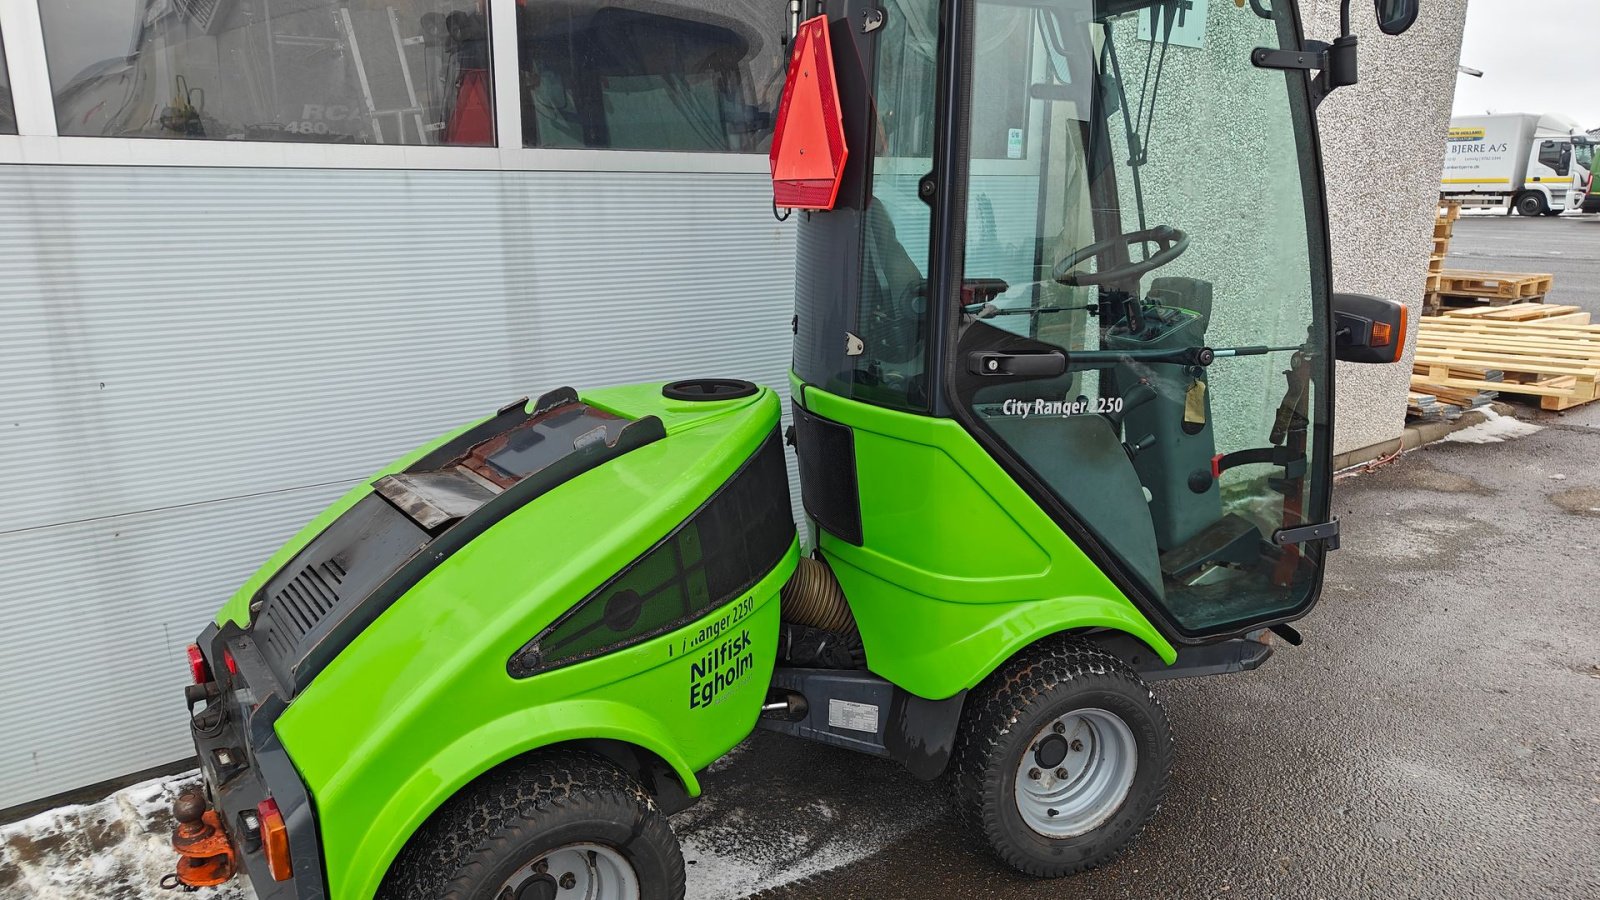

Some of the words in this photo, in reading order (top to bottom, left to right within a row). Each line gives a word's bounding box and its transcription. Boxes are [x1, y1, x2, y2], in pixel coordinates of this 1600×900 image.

[284, 121, 328, 135] 480
[1451, 144, 1485, 154] BJERRE
[1488, 143, 1507, 153] A/S
[1002, 398, 1032, 419] City
[1034, 398, 1087, 418] Ranger
[1088, 397, 1124, 413] 2250
[732, 595, 754, 624] 2250
[691, 630, 752, 681] Nilfisk
[691, 652, 753, 709] Egholm
